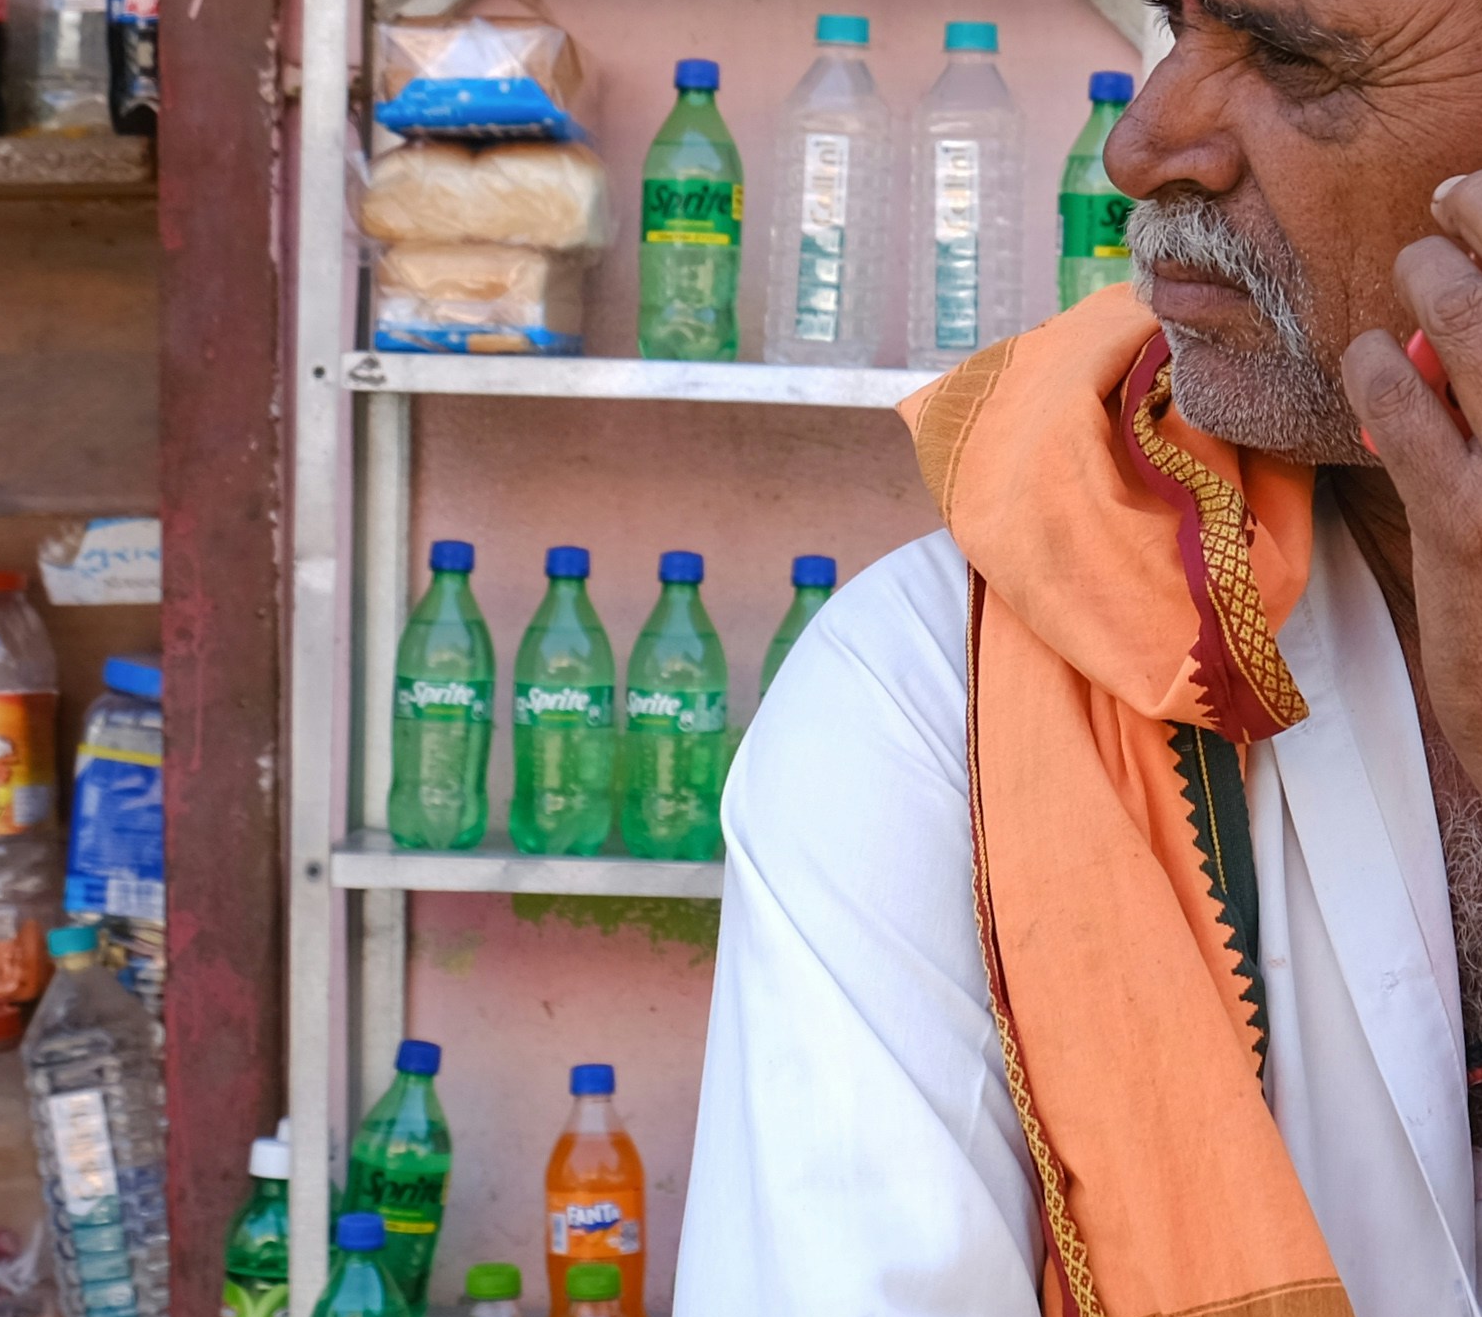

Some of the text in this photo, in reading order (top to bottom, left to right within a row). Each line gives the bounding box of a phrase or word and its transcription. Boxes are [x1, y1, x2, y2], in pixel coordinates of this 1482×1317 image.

[649, 184, 732, 219] Sprite
[411, 680, 477, 708] Sprite
[527, 686, 590, 714] Sprite
